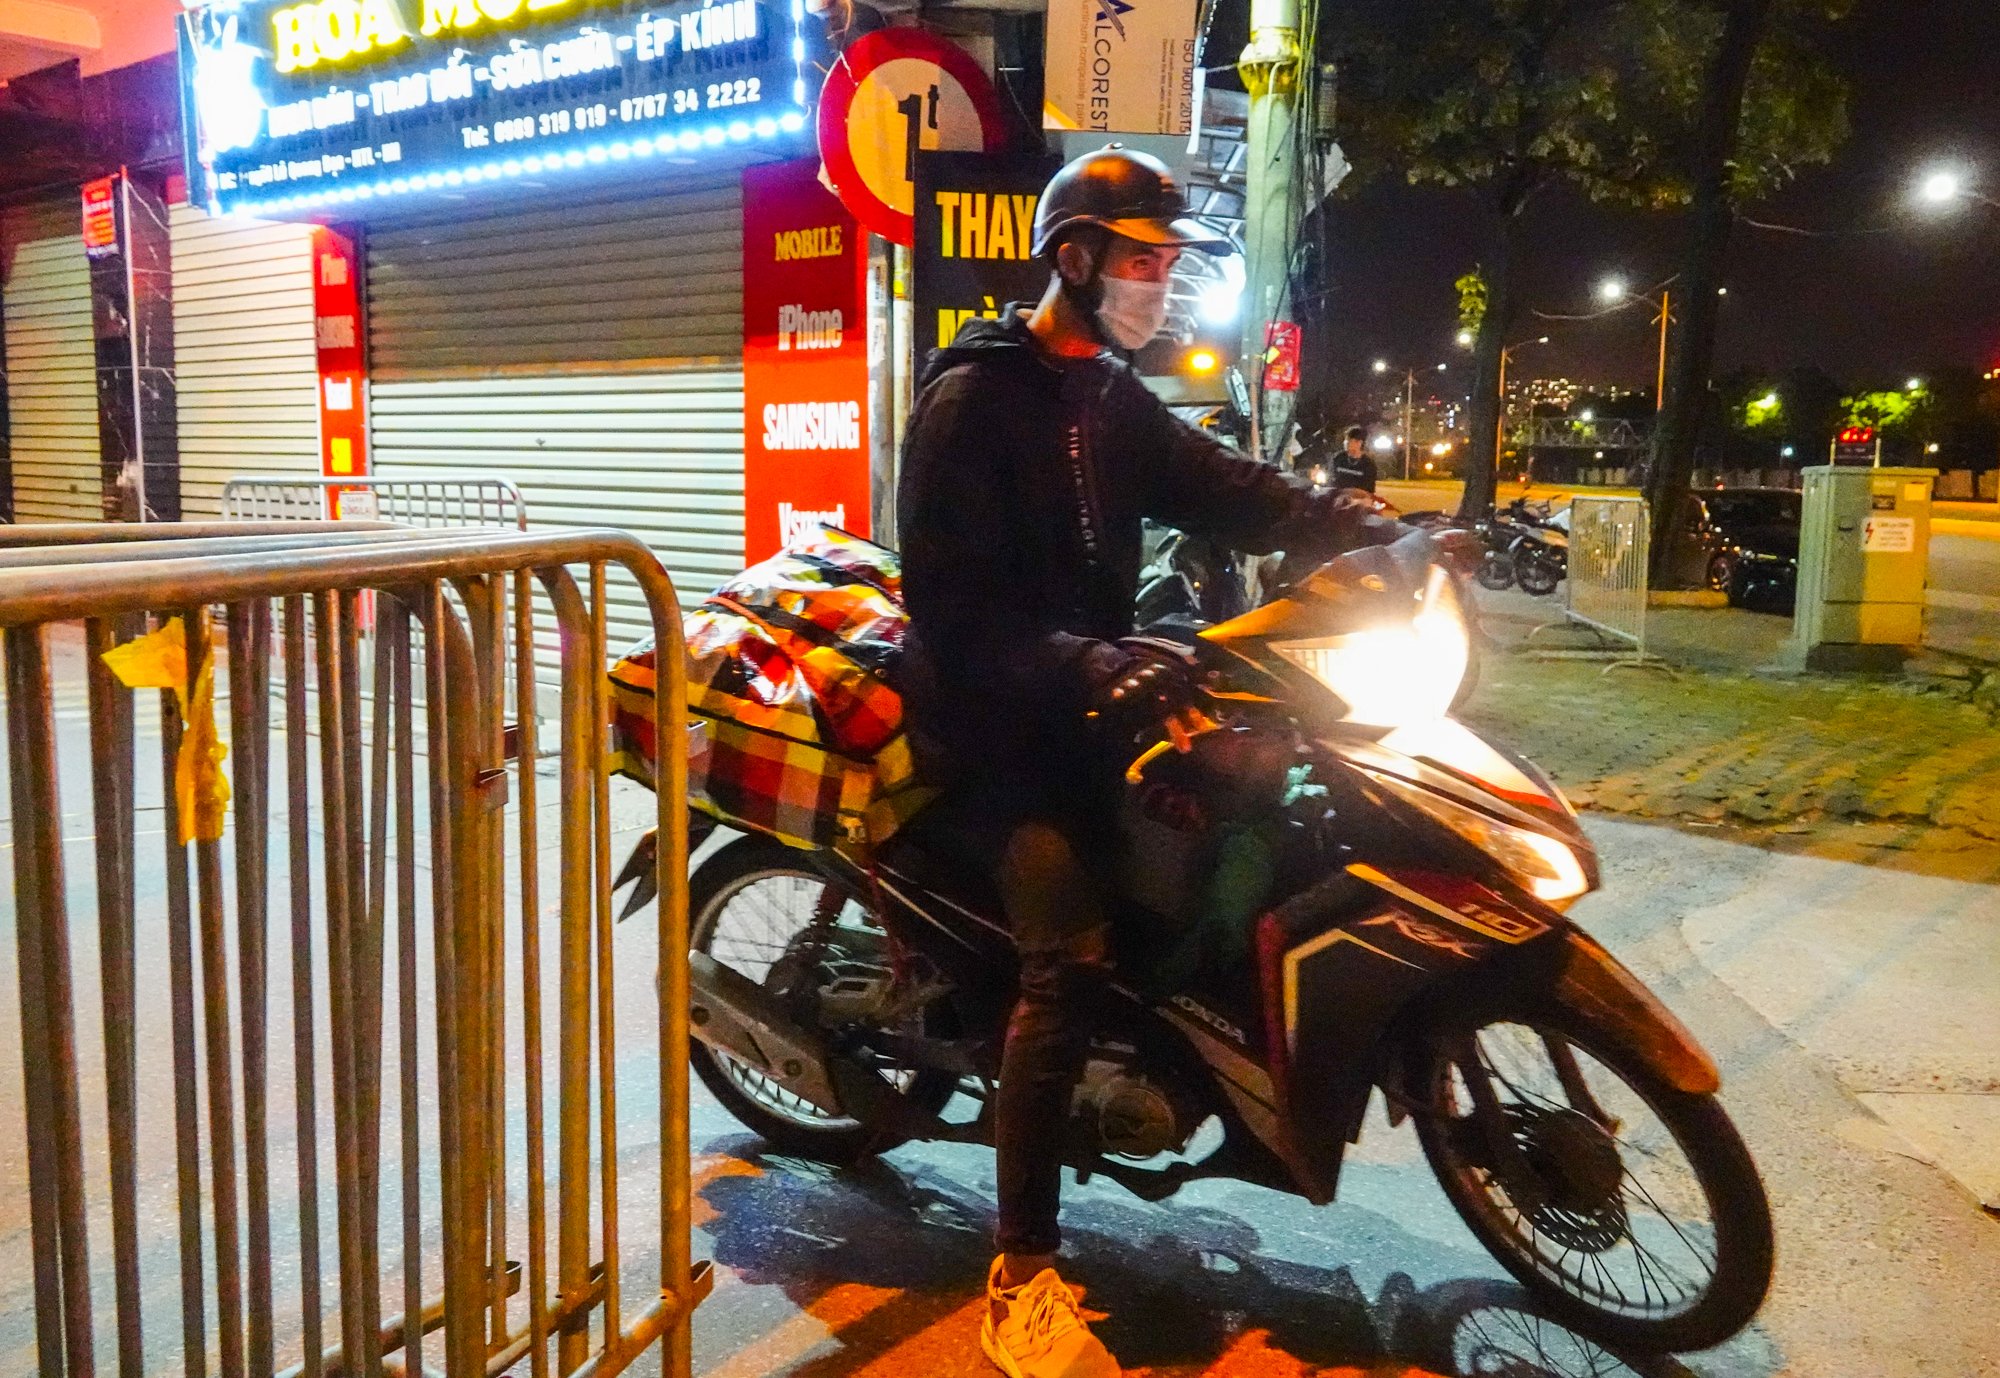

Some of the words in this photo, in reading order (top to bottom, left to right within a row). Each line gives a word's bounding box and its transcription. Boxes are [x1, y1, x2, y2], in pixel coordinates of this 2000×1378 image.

[272, 0, 402, 73] HOA
[636, 12, 675, 61] ÉP
[1182, 39, 1195, 63] ISO
[673, 88, 699, 113] 34
[706, 77, 761, 109] 2222
[774, 225, 843, 261] MOBILE
[935, 191, 1038, 261] THAY
[778, 303, 843, 351] iPhone
[762, 400, 860, 451] SAMSUNG
